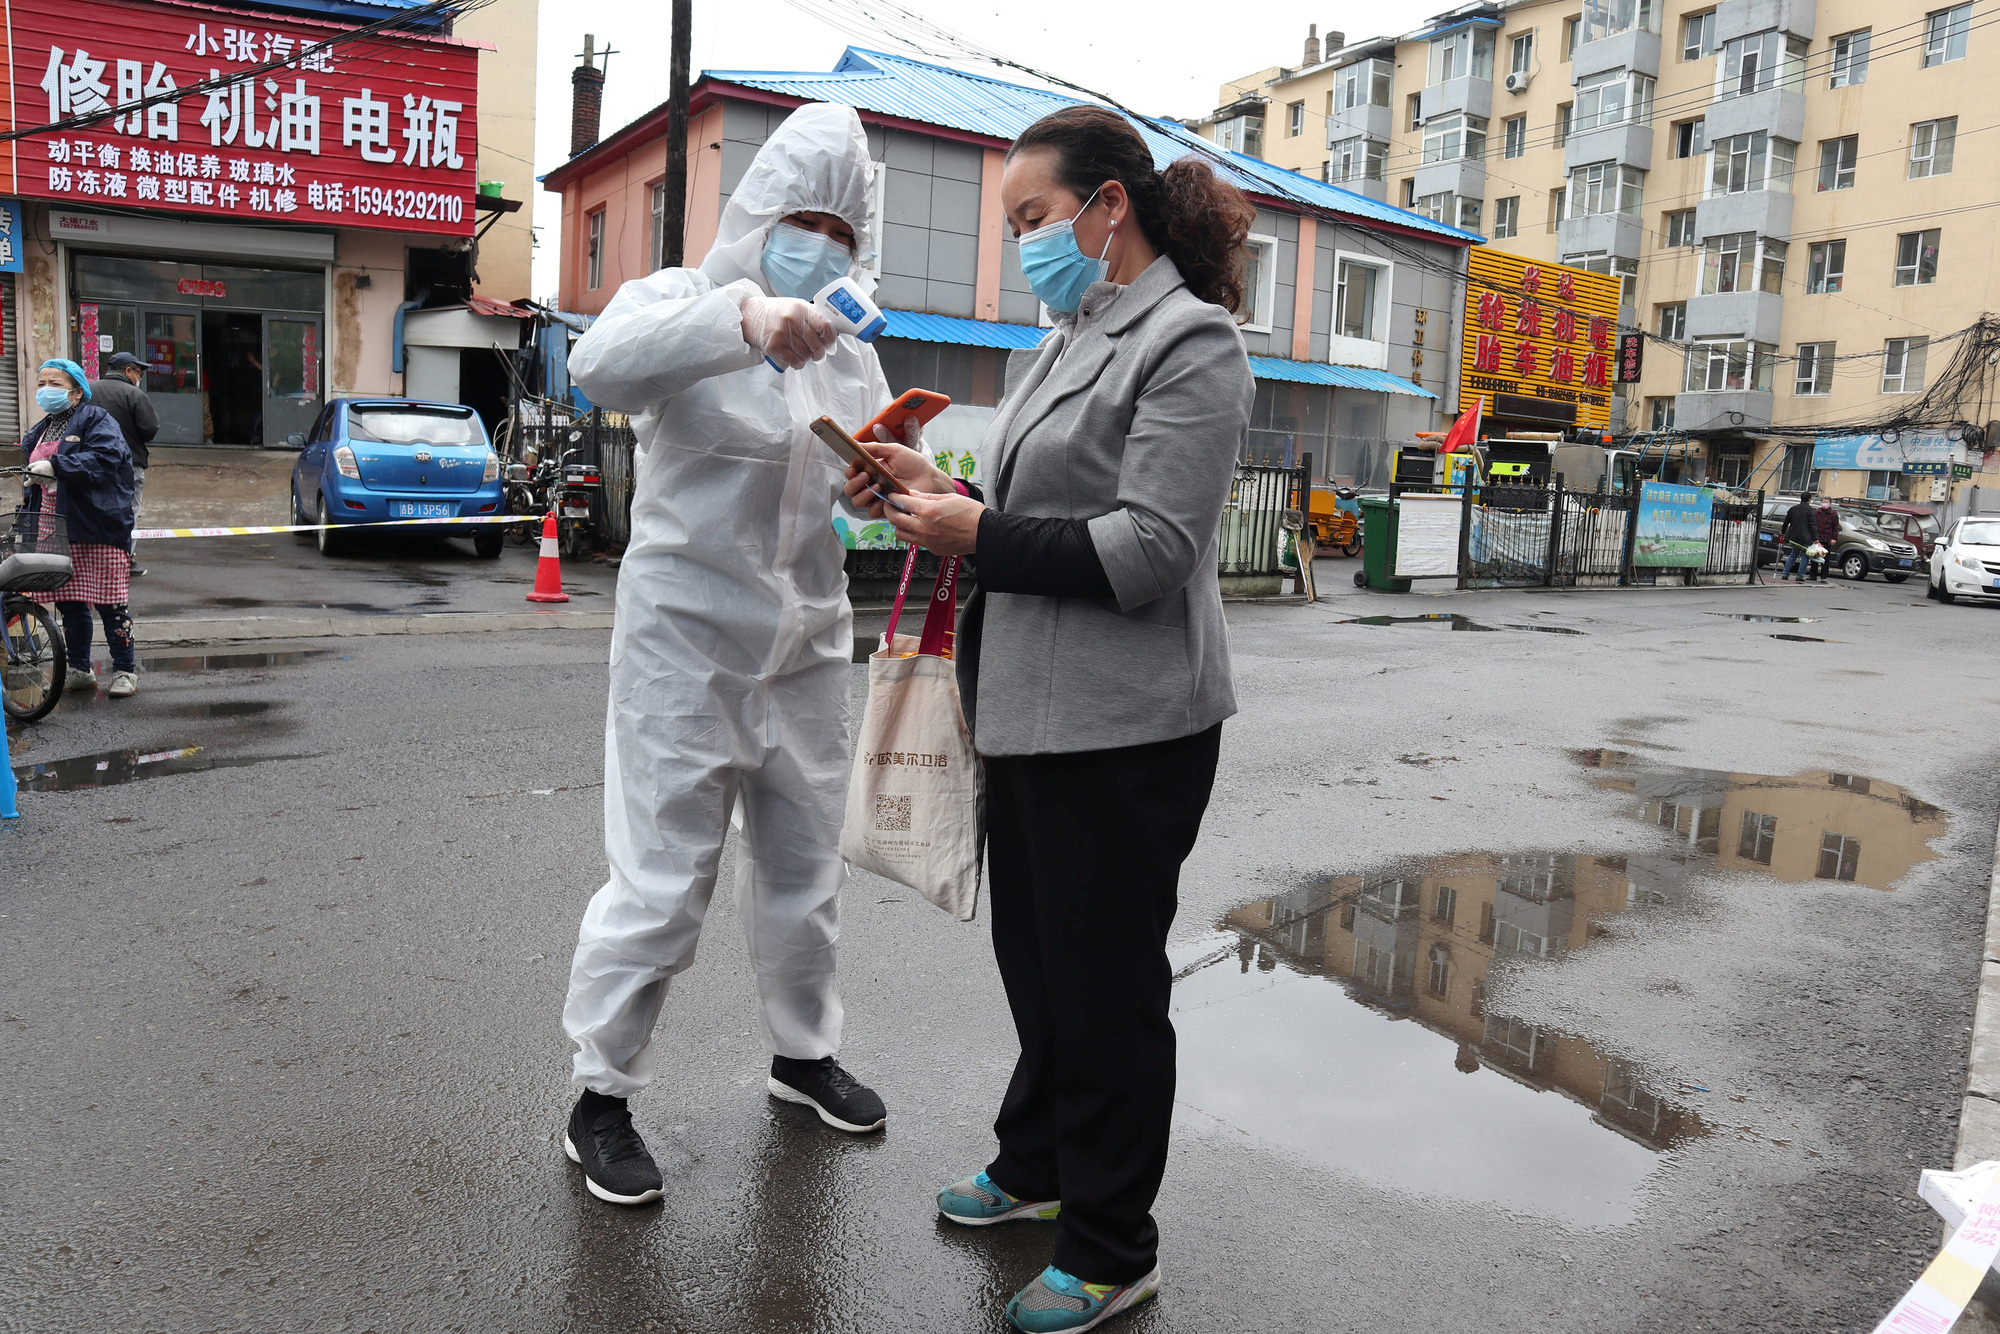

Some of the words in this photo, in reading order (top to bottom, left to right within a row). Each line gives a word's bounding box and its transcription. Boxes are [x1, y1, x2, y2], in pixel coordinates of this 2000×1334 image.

[185, 23, 335, 73] 小张汽配
[40, 44, 179, 142] 修胎
[200, 69, 320, 155] 机油
[343, 88, 464, 169] 电瓶
[48, 138, 121, 169] 动平衡
[130, 147, 221, 180] 换油保养
[229, 158, 296, 187] 玻璃水
[48, 167, 127, 198] 防冻液
[137, 175, 240, 209] 微型配件
[249, 186, 299, 213] 机修
[1521, 266, 1578, 300] 兴达
[1473, 291, 1507, 372] 轮胎
[1513, 299, 1542, 376] 洗车
[1549, 306, 1578, 383] 机油
[1581, 314, 1609, 387] 电瓶
[937, 555, 957, 601] Oume
[877, 751, 948, 768] 欧美尔卫浴
